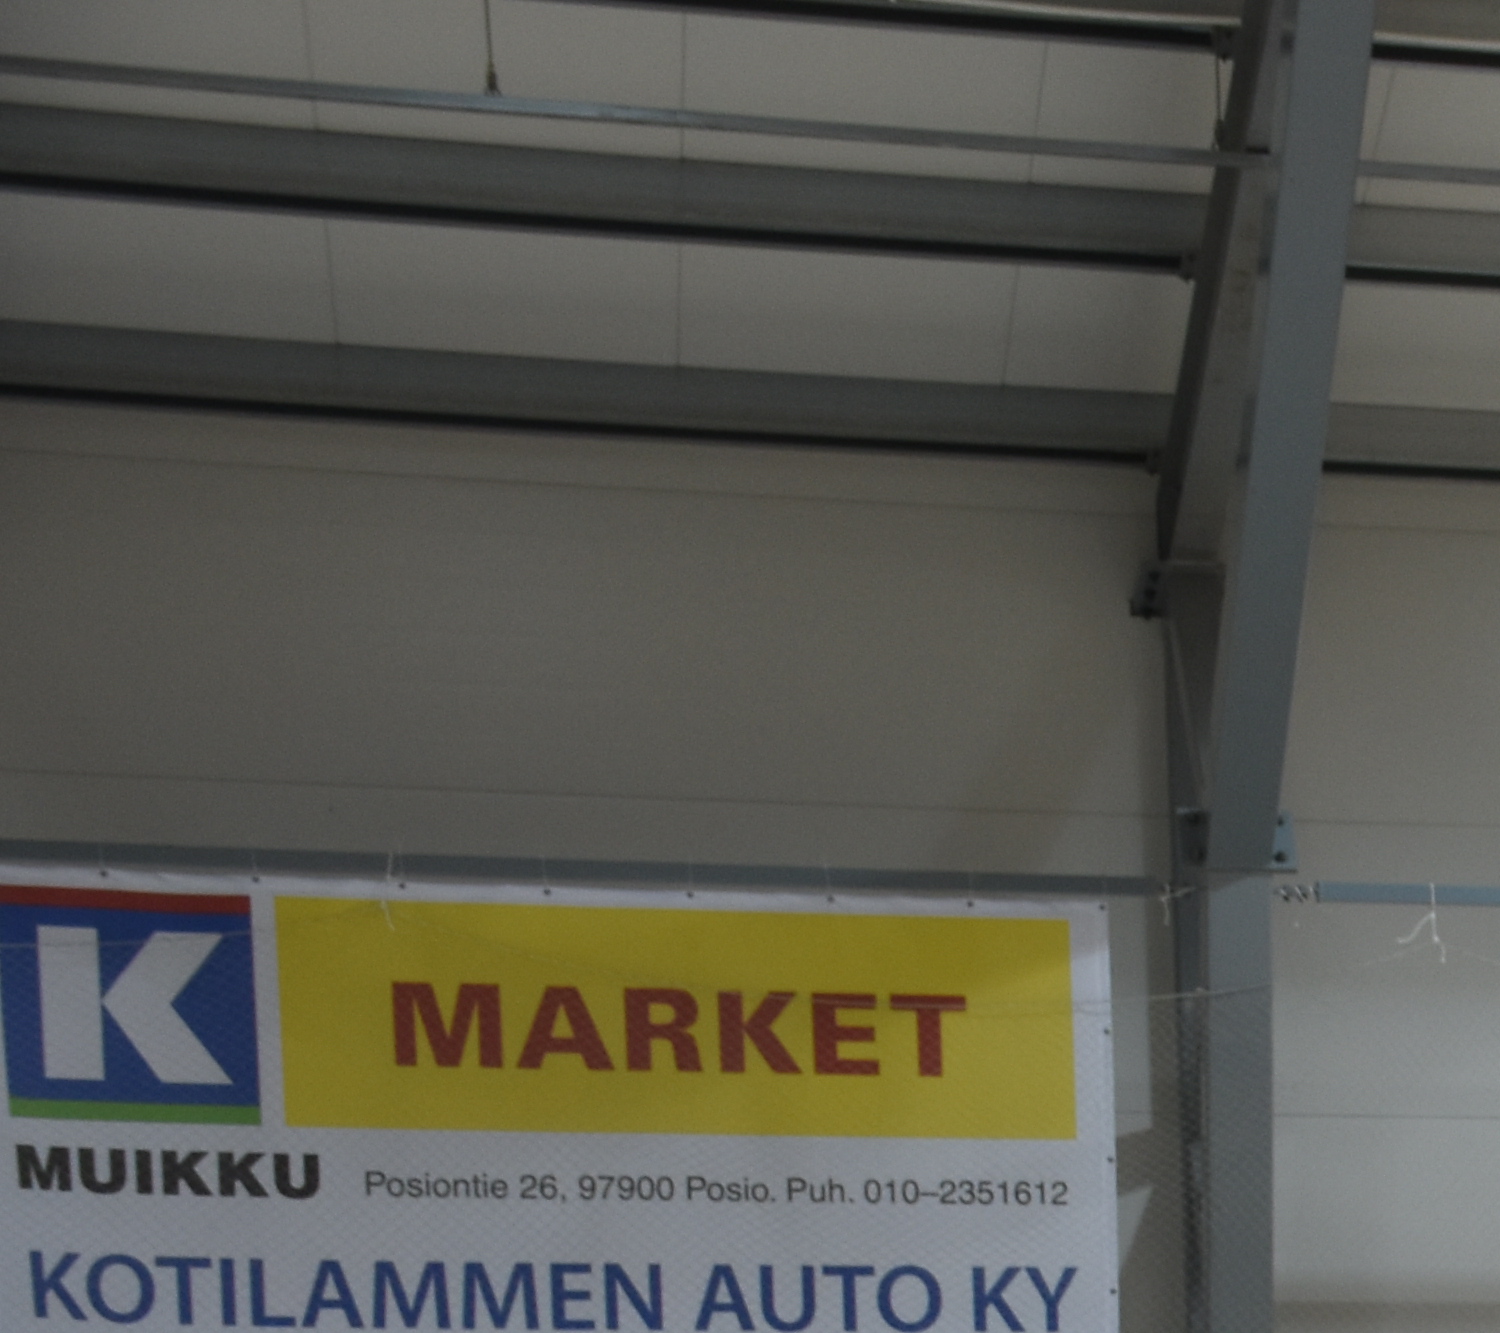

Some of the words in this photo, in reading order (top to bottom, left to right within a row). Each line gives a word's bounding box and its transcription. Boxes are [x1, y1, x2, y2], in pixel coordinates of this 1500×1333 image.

[389, 980, 967, 1079] MARKET
[15, 1142, 323, 1200] MUIKKU
[363, 1169, 508, 1202] Posiontie
[518, 1172, 568, 1204] 26,
[577, 1172, 674, 1202] 97900
[684, 1174, 777, 1204] Posio.
[785, 1176, 856, 1205] Puh.
[27, 1250, 665, 1333] KOTILAMMEN
